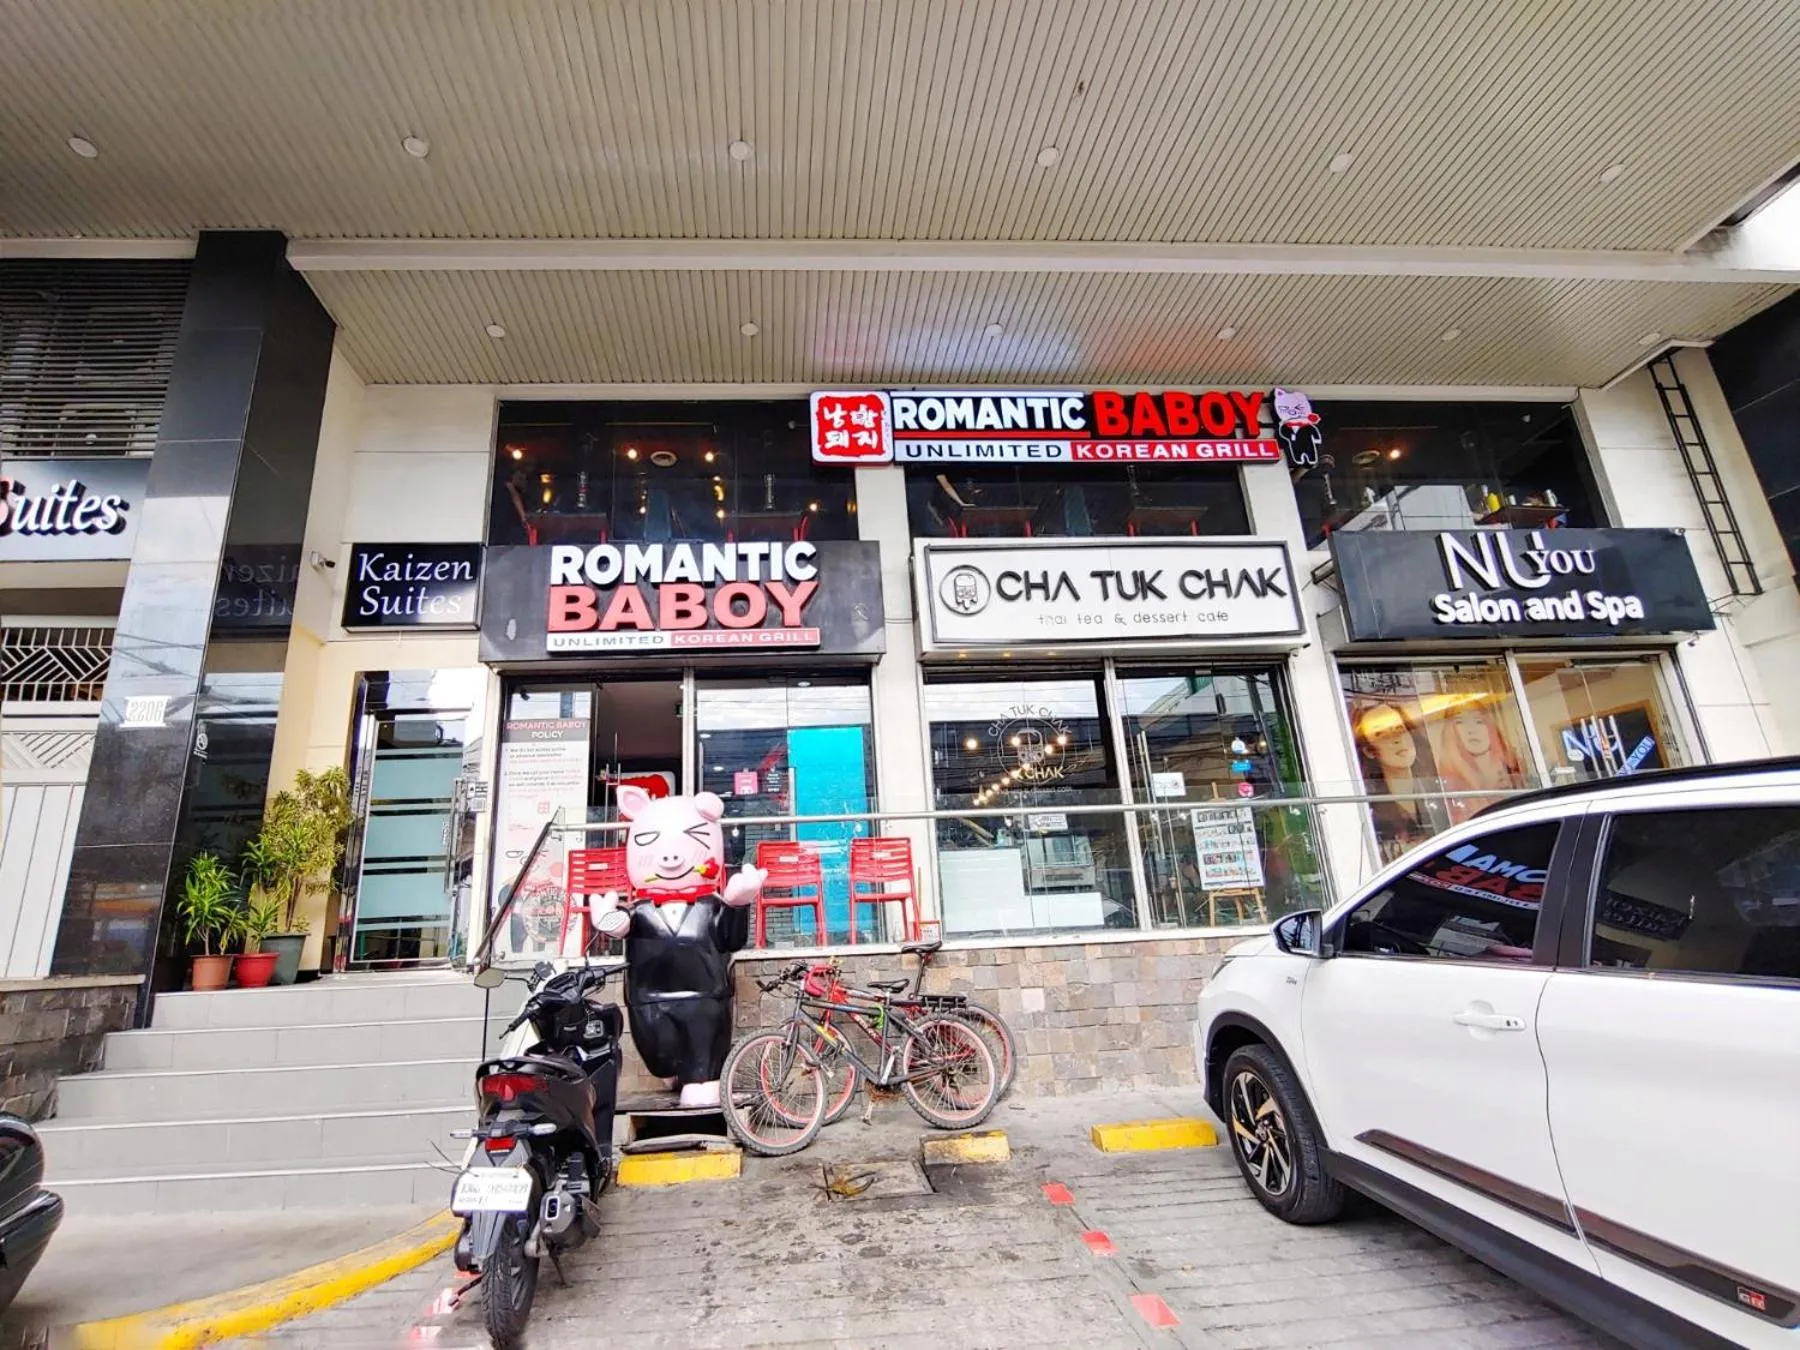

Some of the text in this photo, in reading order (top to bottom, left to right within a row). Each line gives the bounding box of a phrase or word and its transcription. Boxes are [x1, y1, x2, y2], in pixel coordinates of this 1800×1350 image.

[892, 391, 1264, 437] ROMANTIC BABOY
[905, 442, 1275, 459] UNLIMITED KOREAN GRILL
[359, 552, 474, 582] Kaizen
[550, 541, 818, 585] ROMANTIC
[1527, 549, 1596, 574] YOU
[996, 567, 1287, 602] CHA TUK CHAK
[360, 585, 462, 616] Suites
[547, 581, 818, 632] BABOY
[1434, 589, 1645, 626] Salon and Spa
[1077, 613, 1104, 625] tea
[1114, 613, 1128, 625] &
[1133, 612, 1188, 624] dessert
[1198, 610, 1229, 623] cafe
[554, 630, 815, 648] UNLIMITED KOREAN GRILL
[127, 700, 164, 722] 2206
[1009, 704, 1036, 717] TUK
[531, 730, 564, 739] POLICY
